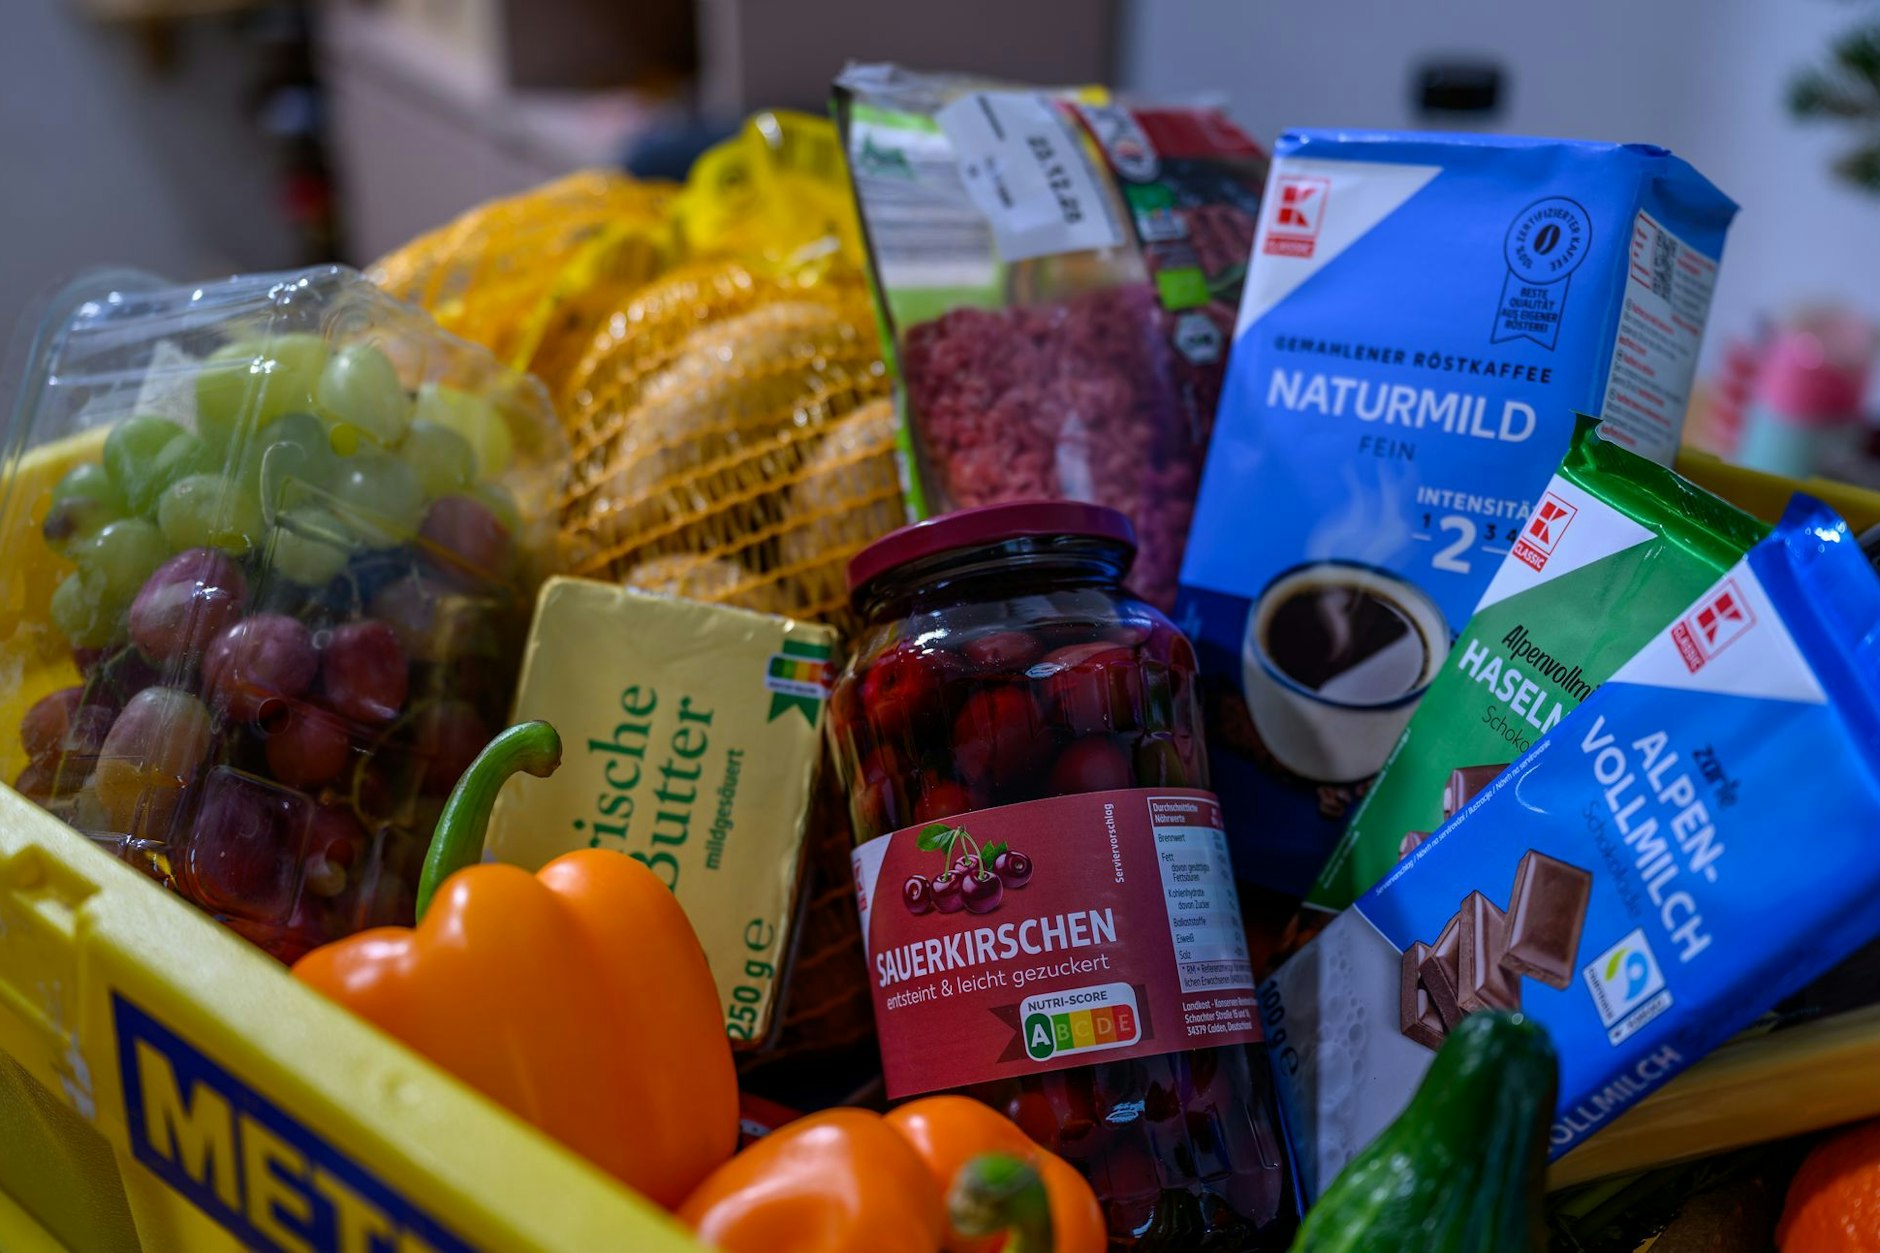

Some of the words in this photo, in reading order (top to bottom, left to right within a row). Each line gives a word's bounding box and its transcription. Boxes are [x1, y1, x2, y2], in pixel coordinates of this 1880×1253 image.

[1520, 286, 1549, 299] BESTE
[1273, 335, 1406, 366] GEMAHLENER
[1413, 347, 1553, 385] RÖSTKAFFEE
[1267, 368, 1537, 443] NATURMILD
[1358, 433, 1416, 461] FEIN
[1416, 485, 1536, 521] INTENSITÄ
[1431, 515, 1477, 575] 2
[1484, 523, 1496, 541] 3
[1516, 542, 1546, 570] CLASSIC
[1501, 624, 1601, 703] Alpenvollm
[705, 747, 746, 871] mildgesäuert
[1631, 730, 1726, 884] ALPEN-
[1104, 803, 1124, 883] Serviervorschlag
[1158, 833, 1186, 842] Brennwert
[1161, 852, 1175, 862] Fett
[1581, 715, 1712, 964] VOLLMILCH
[1168, 888, 1205, 899] Kohlenhydrate
[1178, 901, 1194, 910] davon
[876, 908, 1118, 988] SAUERKIRSCHEN
[1179, 950, 1192, 960] Salz
[726, 984, 762, 1041] 250
[744, 958, 775, 980] g
[887, 982, 937, 1011] entsteint
[941, 979, 953, 997] &
[956, 970, 1006, 994] leicht
[1012, 953, 1111, 988] gezuckert
[1028, 990, 1108, 1012] NUTRI-SCORE
[1031, 1023, 1051, 1048] A
[1186, 1024, 1207, 1037] 34379
[1548, 1045, 1683, 1155] OLLMILCH
[133, 1033, 438, 1253] MET
